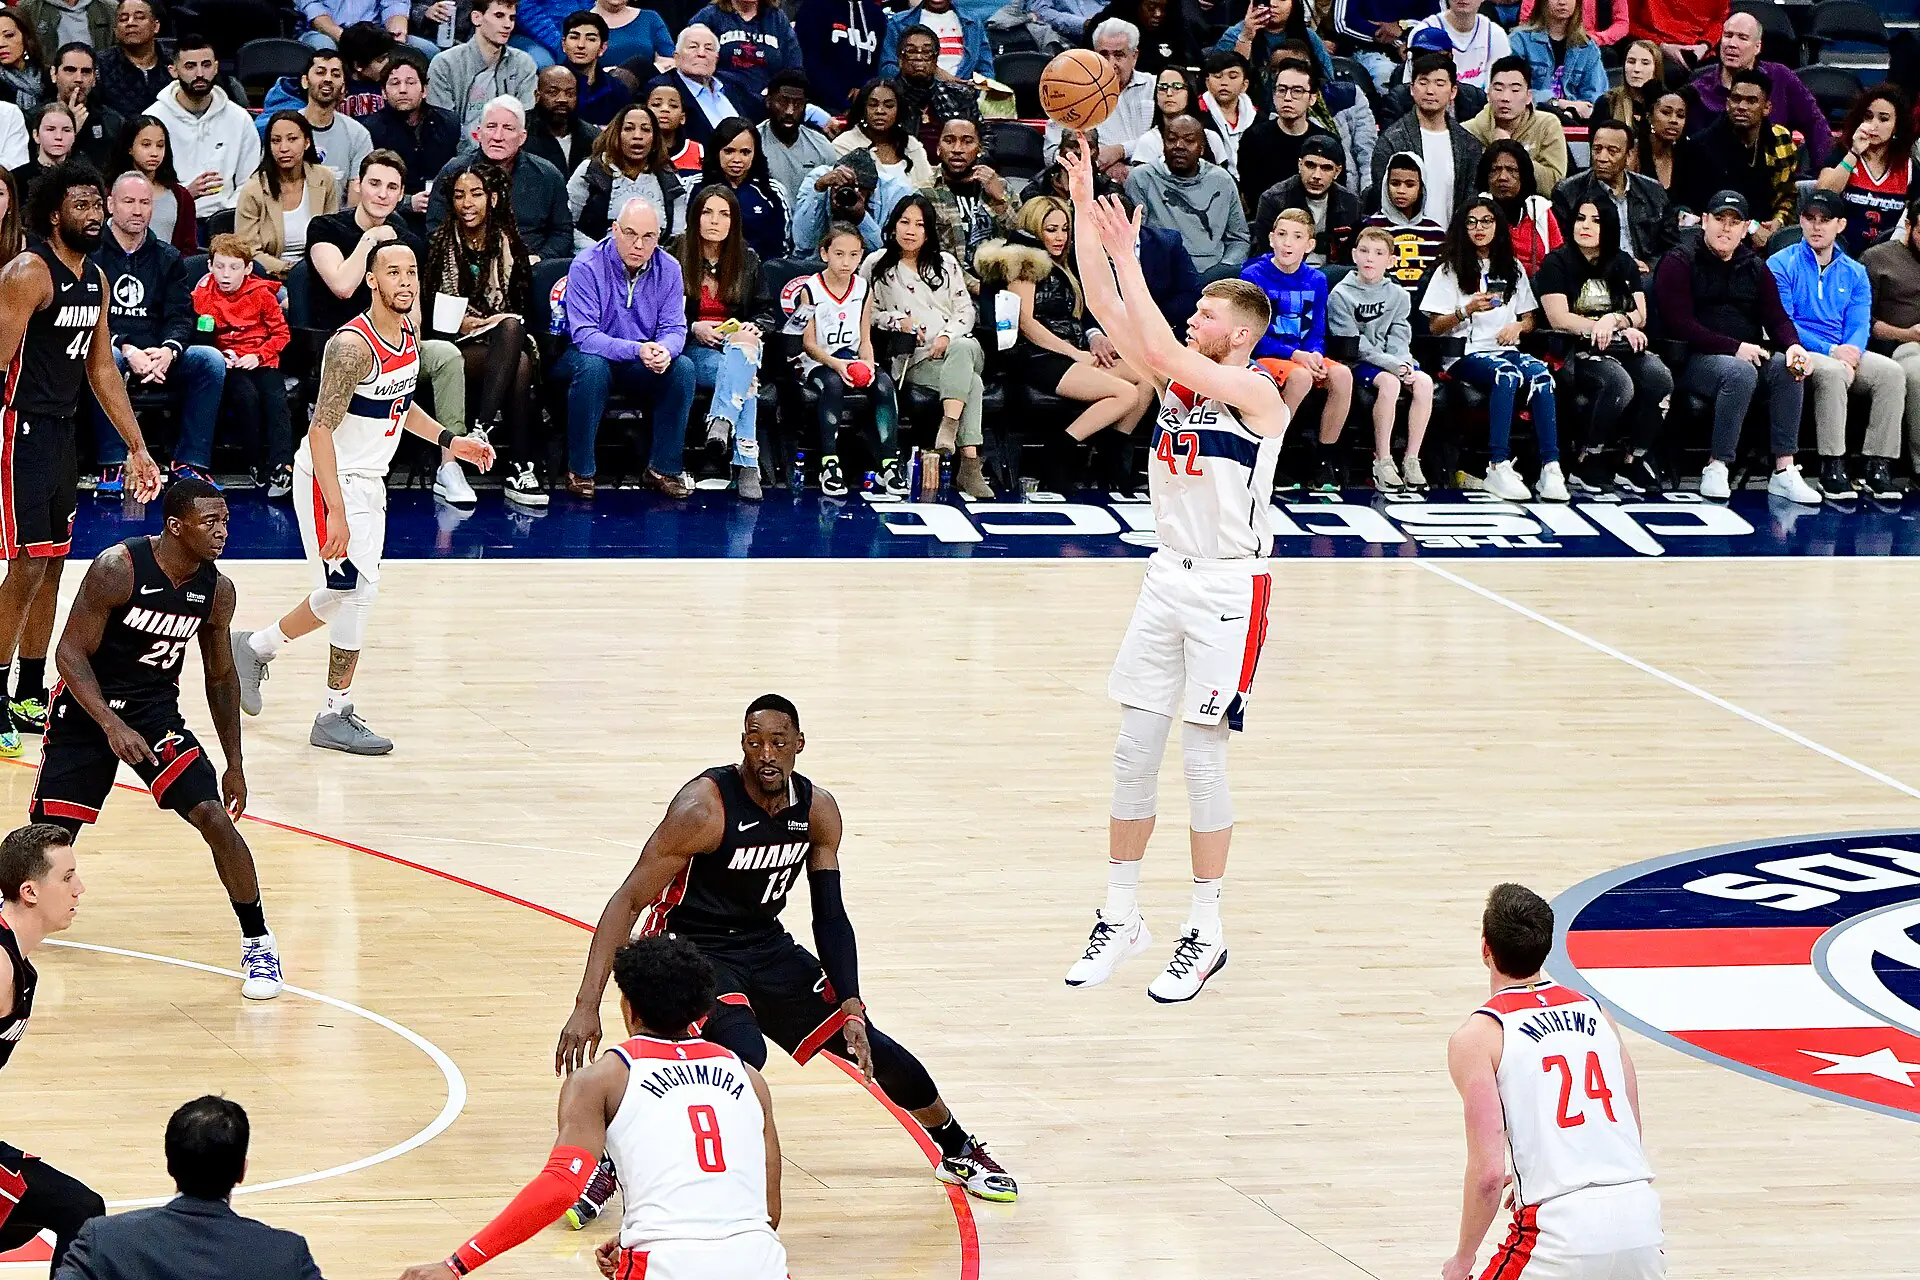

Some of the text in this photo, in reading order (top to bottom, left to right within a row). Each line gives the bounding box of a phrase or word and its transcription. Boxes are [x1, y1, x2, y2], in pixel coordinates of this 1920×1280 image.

[1862, 211, 1880, 239] 3
[54, 306, 101, 327] MIAM
[1359, 301, 1386, 315] NIKE
[66, 331, 94, 359] 44
[385, 397, 405, 436] 5
[1156, 431, 1203, 476] 42
[123, 606, 201, 638] MIAMI
[138, 640, 186, 669] 25
[728, 842, 810, 870] MIAMI
[761, 867, 792, 904] 13
[1518, 1010, 1597, 1043] MATHEWS
[640, 1064, 745, 1100] HACHIMURA
[1542, 1051, 1618, 1128] 24
[688, 1104, 727, 1173] 8
